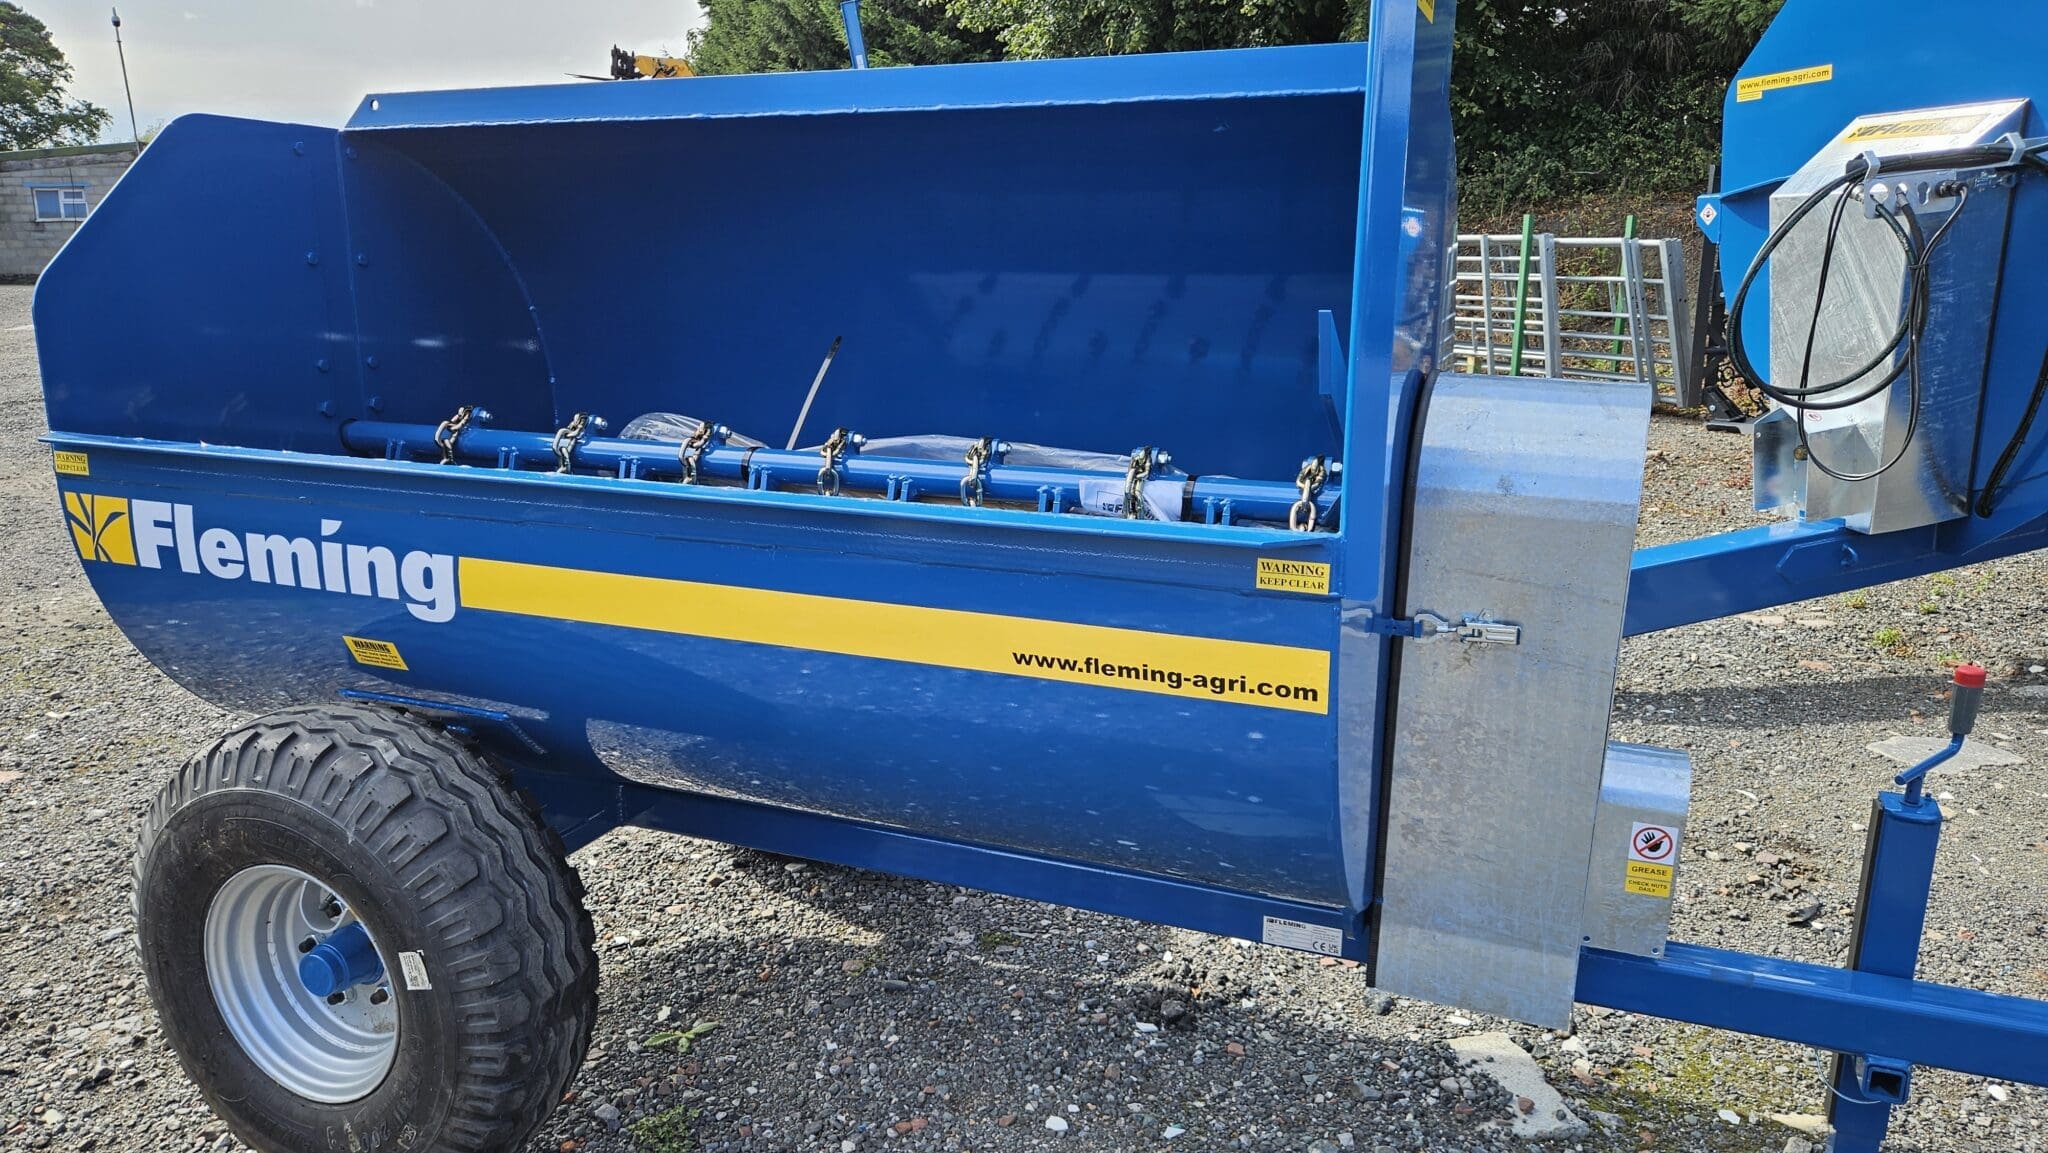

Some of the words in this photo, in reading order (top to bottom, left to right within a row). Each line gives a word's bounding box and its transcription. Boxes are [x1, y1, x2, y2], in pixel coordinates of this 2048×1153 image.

[1740, 70, 1829, 90] www.fleming-agri.com
[56, 453, 86, 463] WARNING
[131, 499, 456, 623] Fleming
[1261, 561, 1325, 577] WARNING
[1260, 576, 1287, 586] KEEP
[1288, 579, 1325, 590] CLEAR
[351, 639, 392, 653] WARNING
[1012, 651, 1319, 702] www.fleming-agri.com
[1631, 865, 1668, 877] GREASE
[1628, 879, 1650, 887] CHECK
